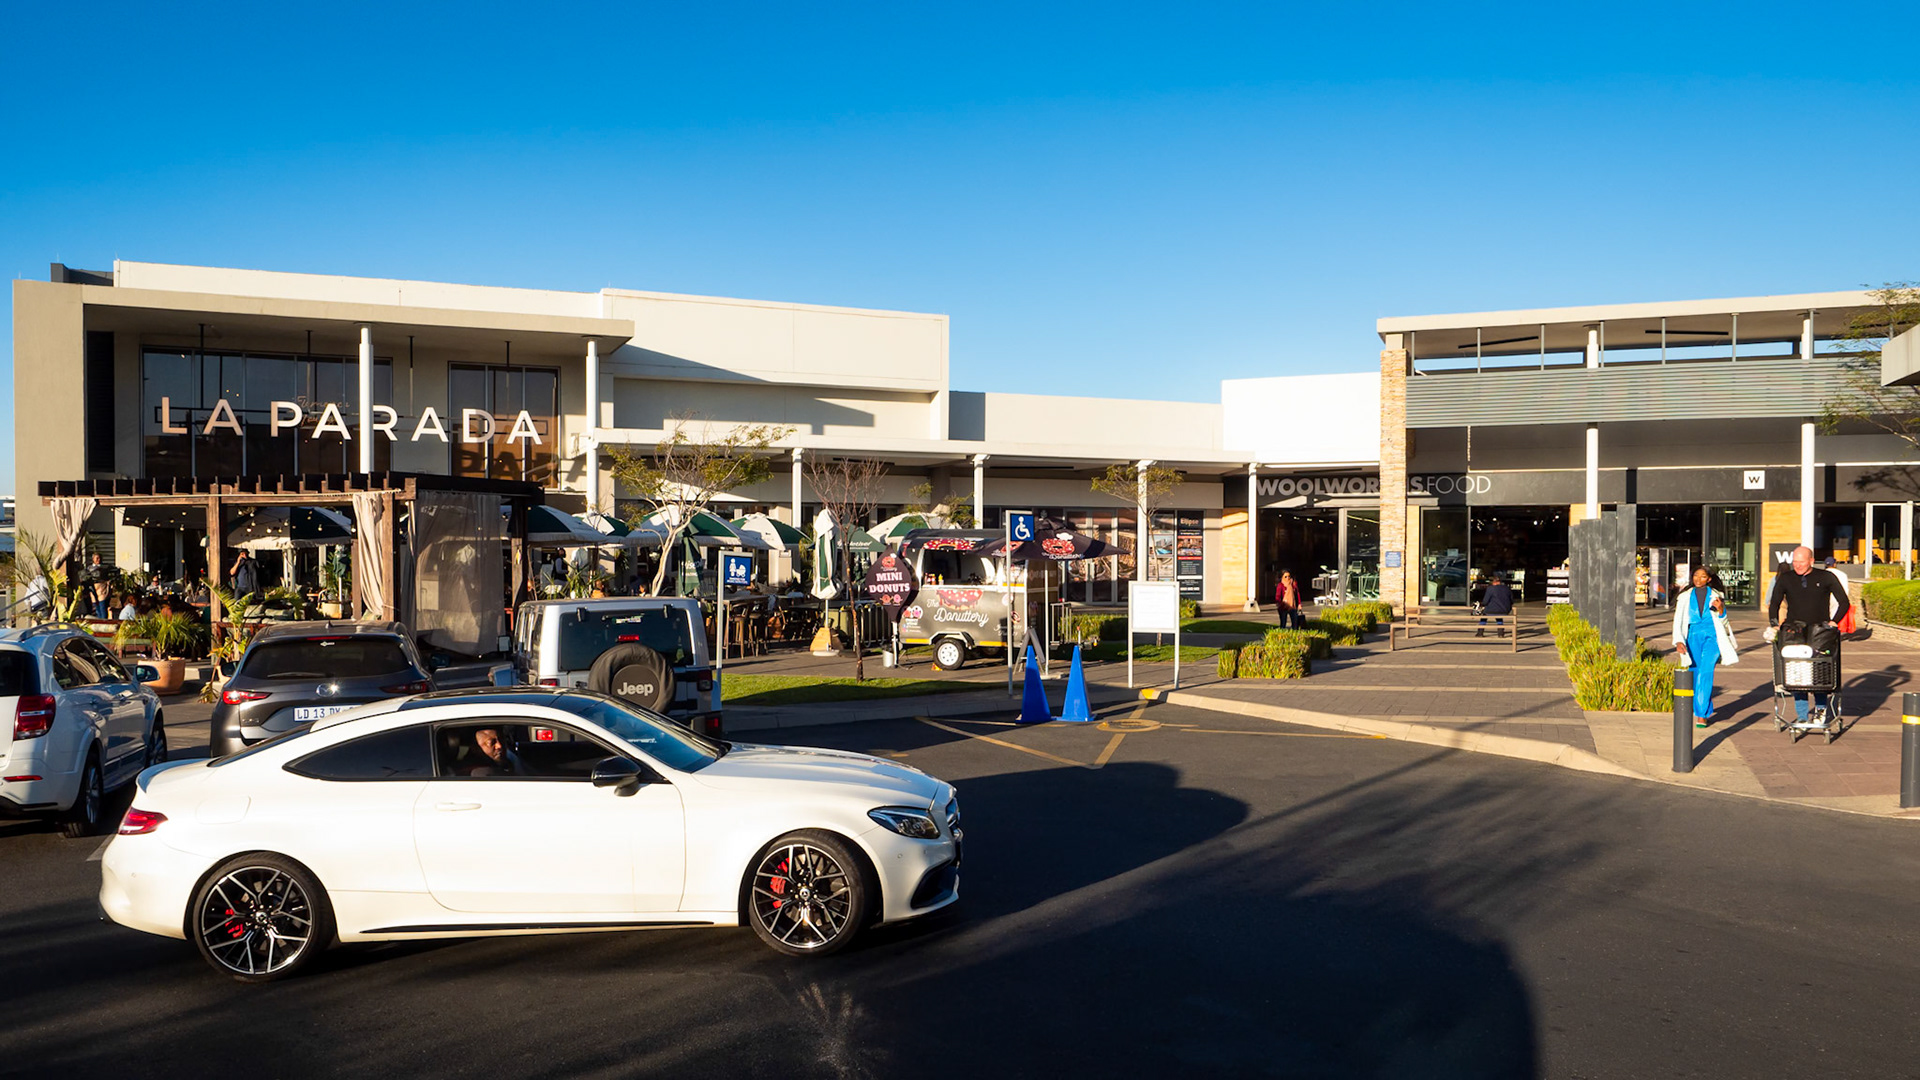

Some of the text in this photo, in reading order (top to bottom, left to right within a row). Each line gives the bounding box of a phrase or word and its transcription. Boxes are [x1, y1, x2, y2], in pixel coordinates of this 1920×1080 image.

[161, 396, 542, 445] LA PARADA
[1256, 476, 1424, 495] WOOLWORS
[876, 571, 903, 582] MINI
[869, 583, 910, 593] DONUTS
[927, 599, 939, 608] The
[934, 607, 989, 627] Donuttery
[617, 682, 654, 696] Jeep
[297, 709, 309, 719] LD
[313, 708, 325, 718] 13
